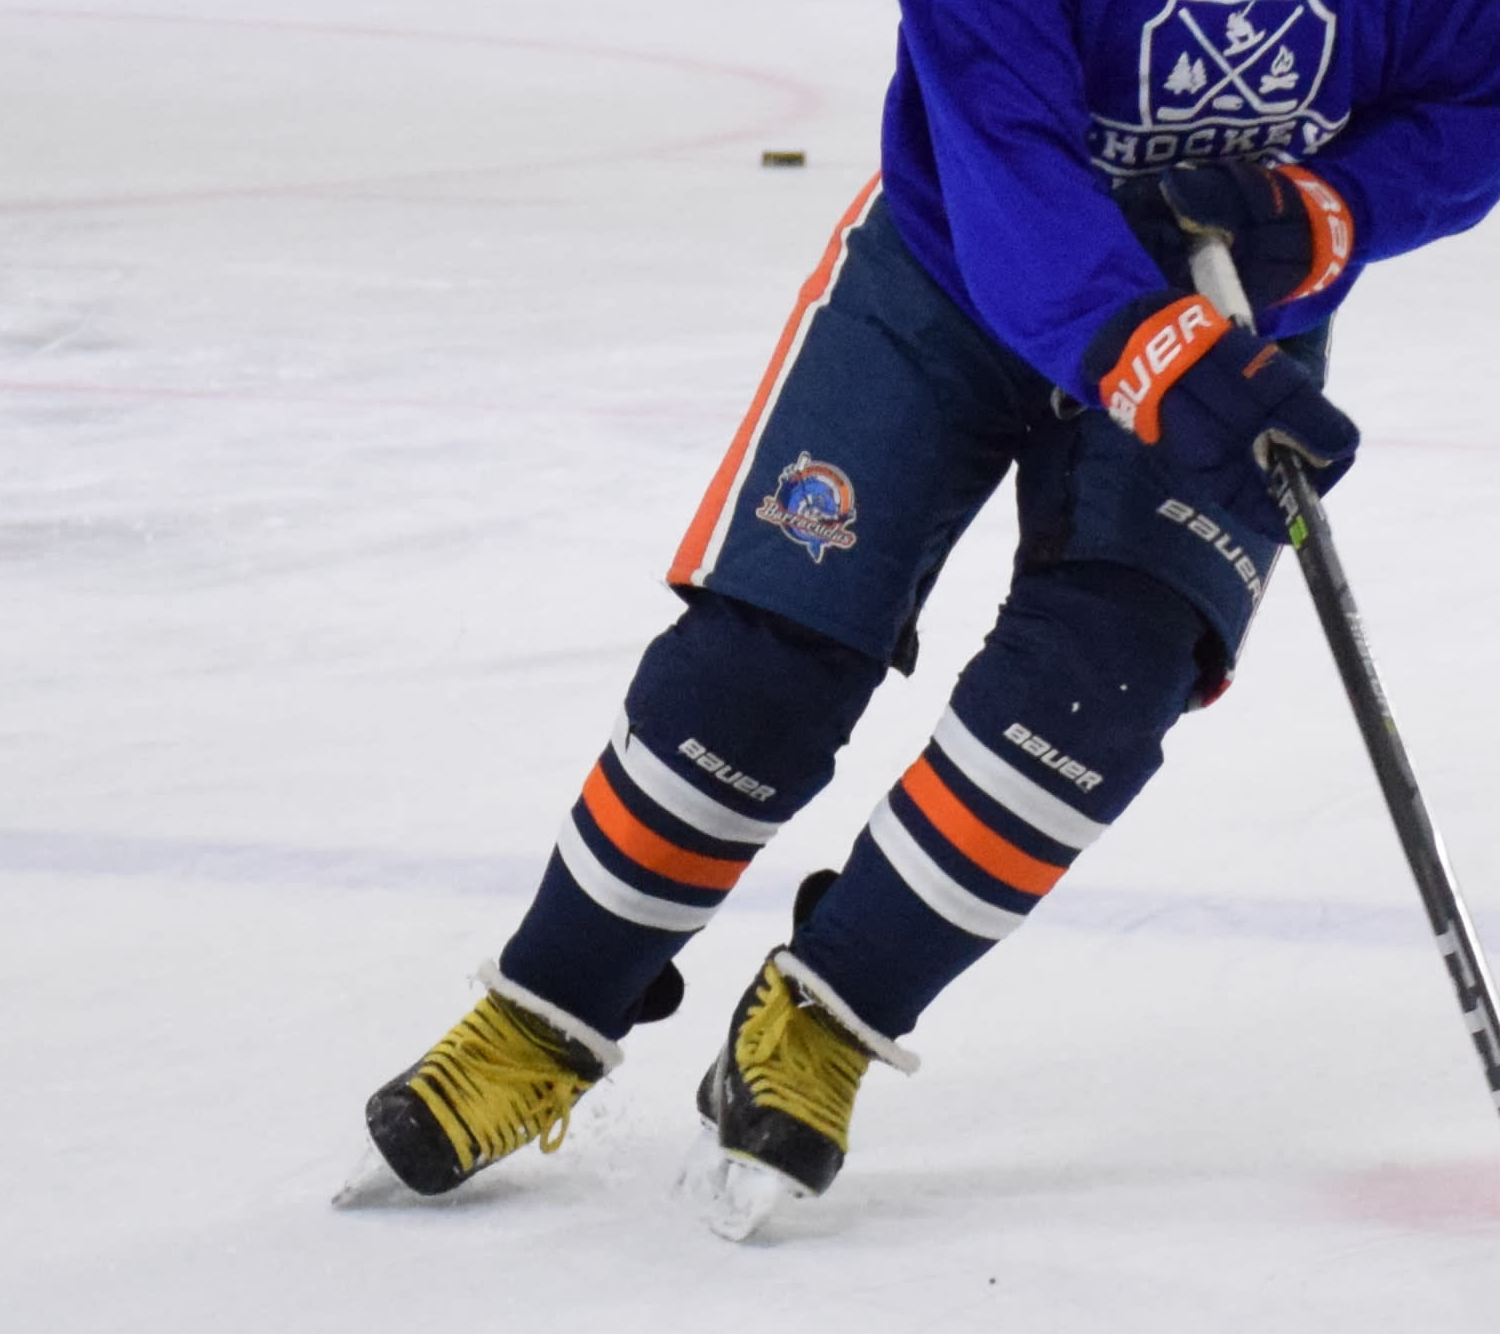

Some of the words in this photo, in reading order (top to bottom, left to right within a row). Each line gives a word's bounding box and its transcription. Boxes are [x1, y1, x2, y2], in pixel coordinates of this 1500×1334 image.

[1102, 120, 1334, 164] HOCKEY
[1108, 303, 1213, 433] AUER
[677, 737, 777, 802] BAUER
[1002, 722, 1104, 795] BAUER
